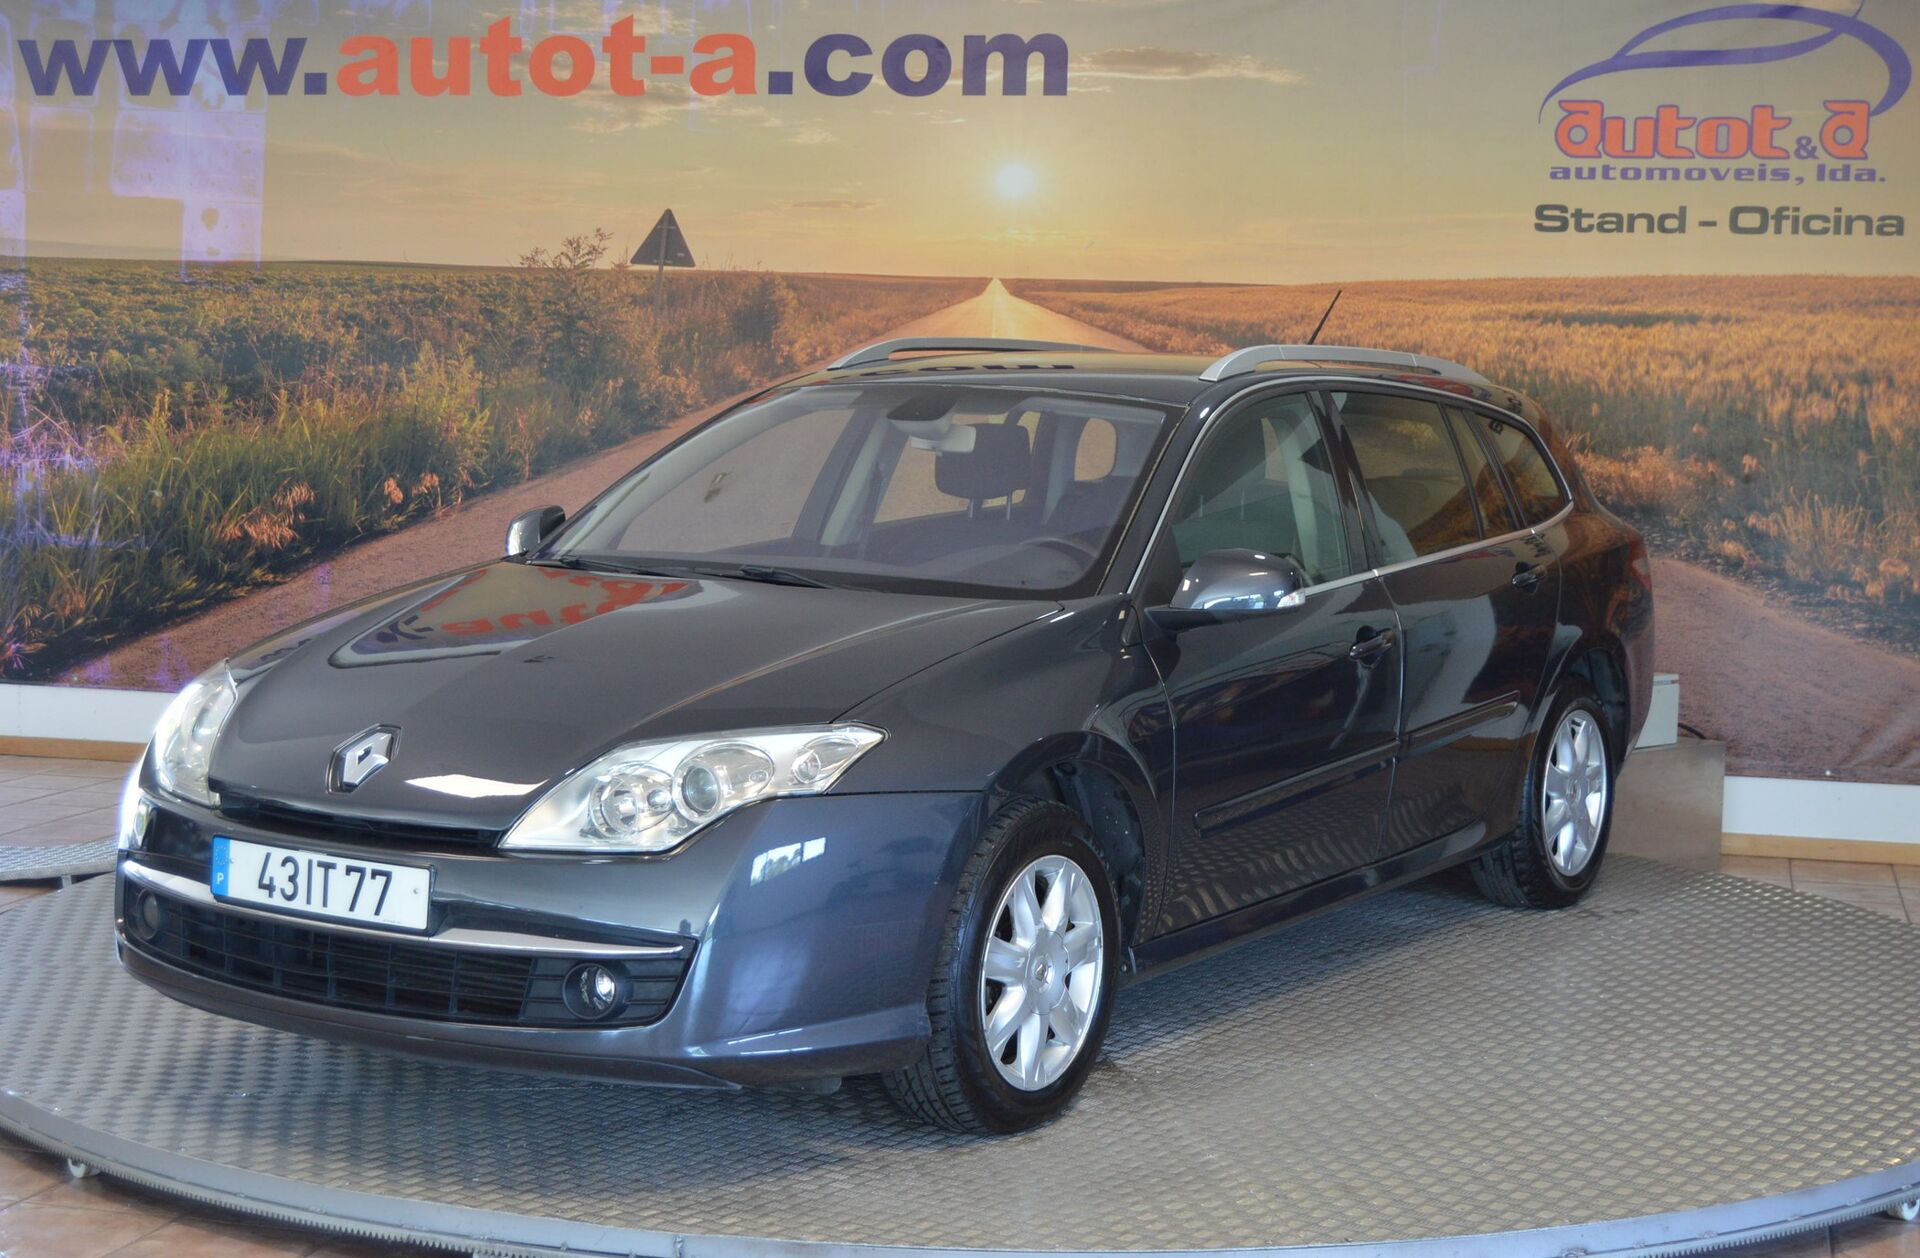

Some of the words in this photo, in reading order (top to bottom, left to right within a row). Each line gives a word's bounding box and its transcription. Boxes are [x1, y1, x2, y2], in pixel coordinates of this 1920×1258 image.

[18, 14, 1070, 97] www.autot-a.com
[1549, 163, 1804, 185] automoveis,
[1816, 164, 1886, 183] lda.
[1534, 204, 1687, 234] Stand
[1728, 205, 1905, 237] Oficina
[215, 871, 226, 886] P
